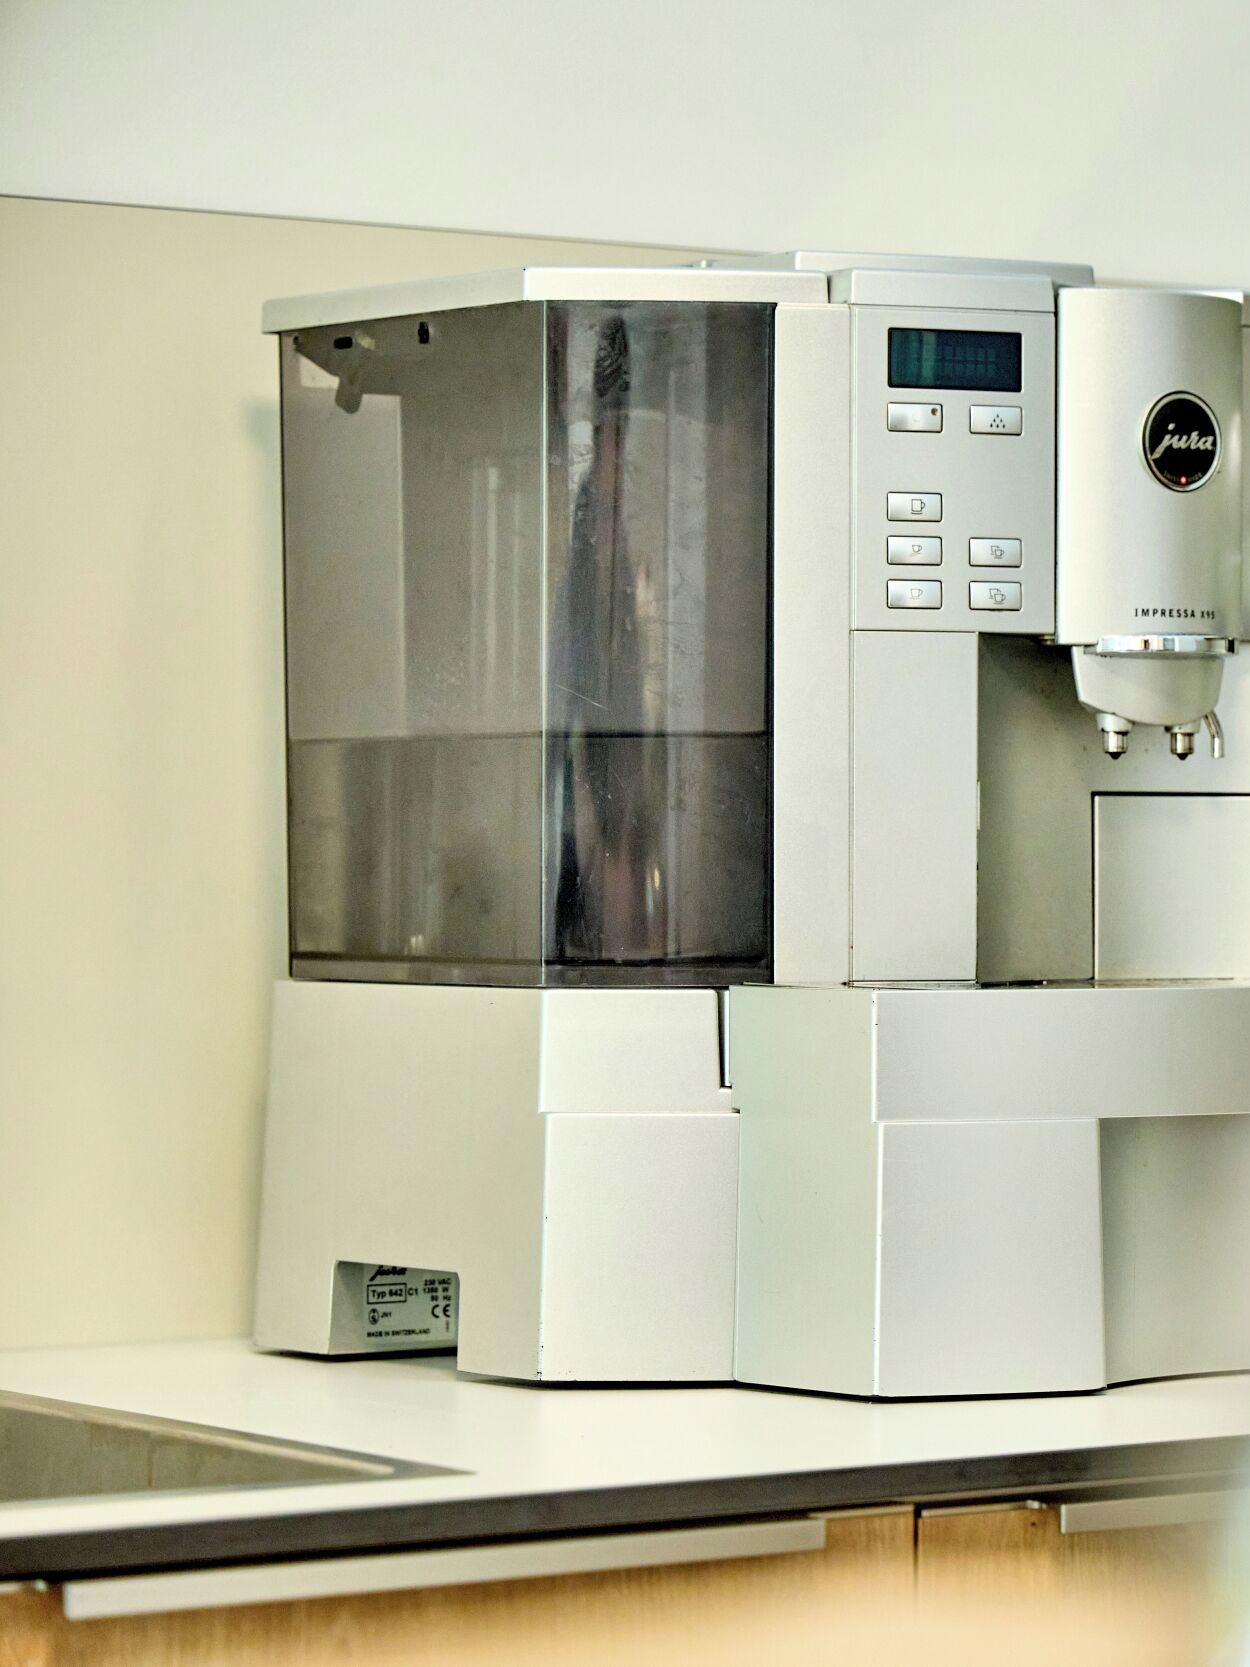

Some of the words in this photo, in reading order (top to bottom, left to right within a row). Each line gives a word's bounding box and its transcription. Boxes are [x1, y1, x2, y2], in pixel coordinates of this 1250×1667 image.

[1150, 423, 1215, 460] jura
[1134, 608, 1196, 618] IMPRESSA
[371, 1289, 387, 1299] Typ
[388, 1288, 403, 1297] 642
[407, 1288, 418, 1296] C1
[391, 1328, 431, 1337] SWITZERLAND
